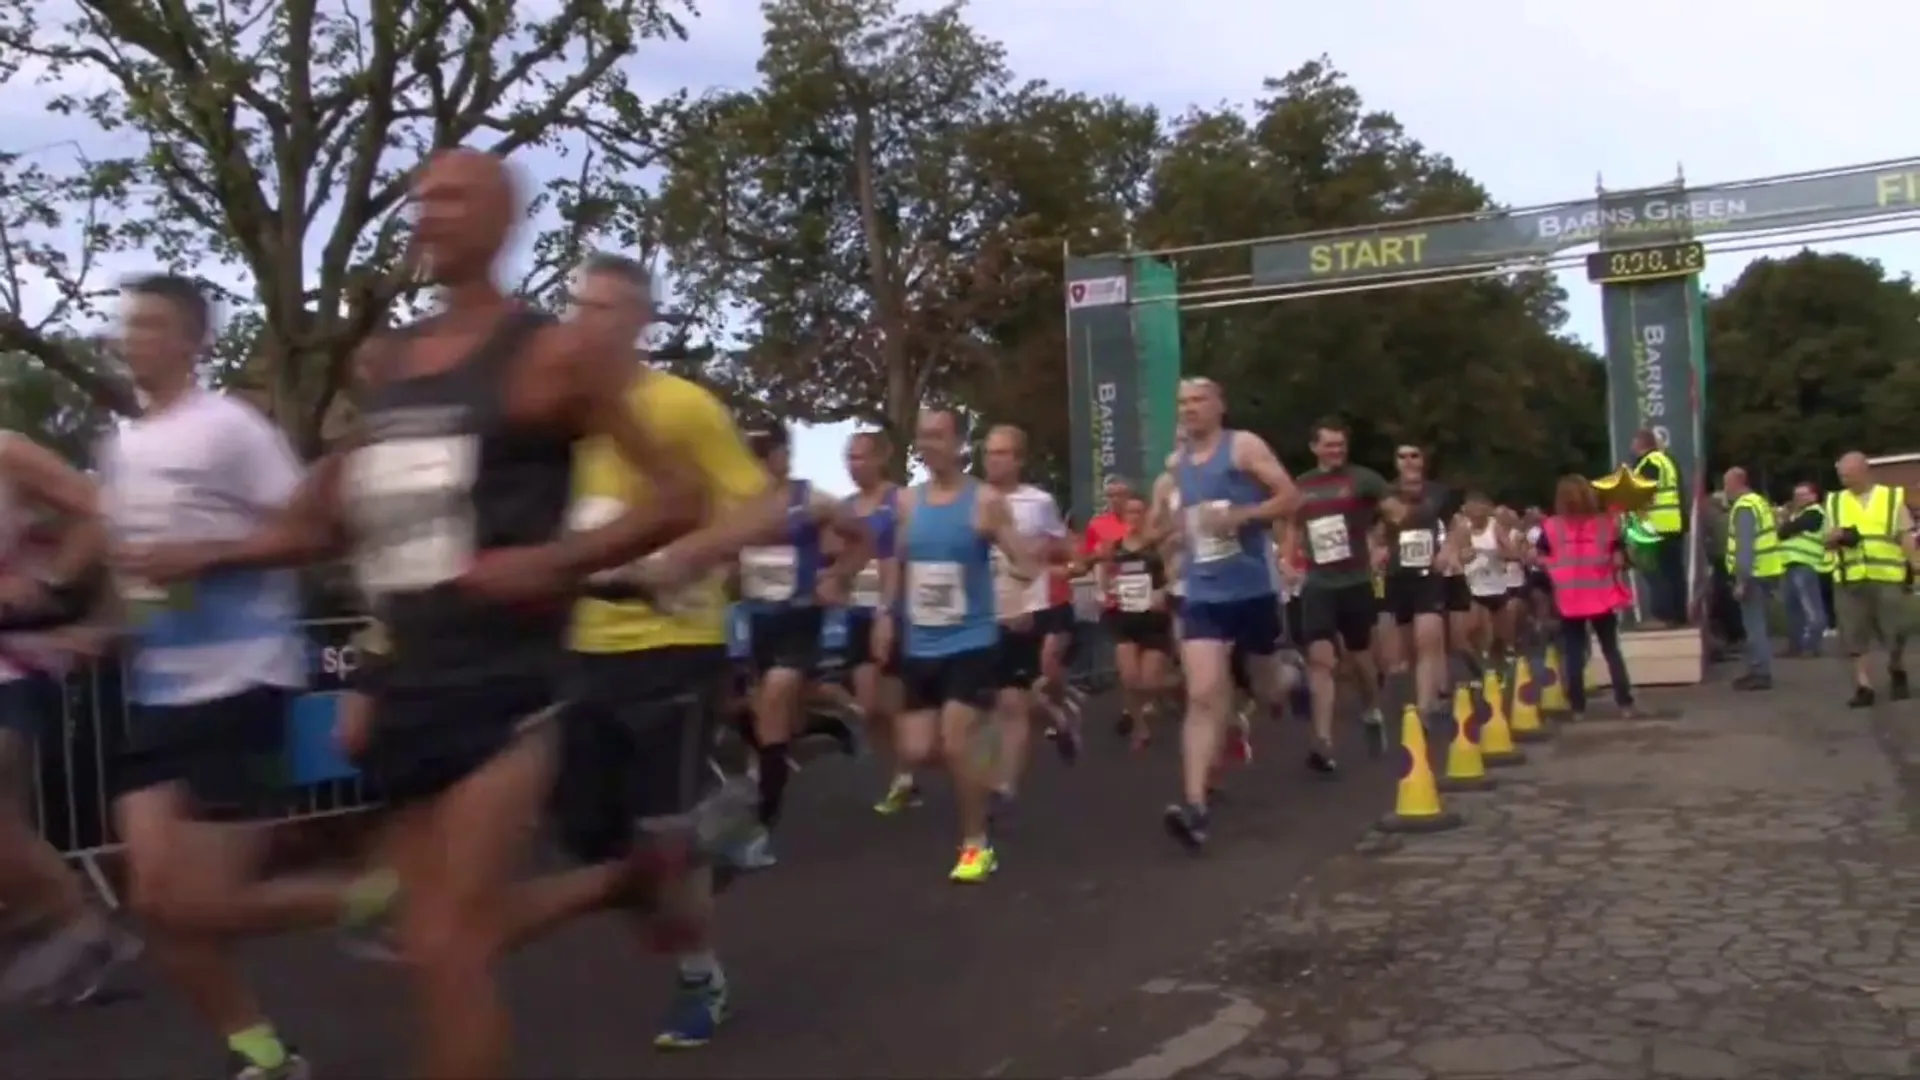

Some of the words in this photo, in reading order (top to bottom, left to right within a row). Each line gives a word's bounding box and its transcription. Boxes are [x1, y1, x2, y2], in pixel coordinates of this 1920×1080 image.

[1538, 206, 1636, 238] BARNS
[1643, 199, 1747, 222] GREEN
[1309, 232, 1428, 273] START
[1643, 324, 1665, 418] BARNS
[1097, 381, 1117, 468] BARNS
